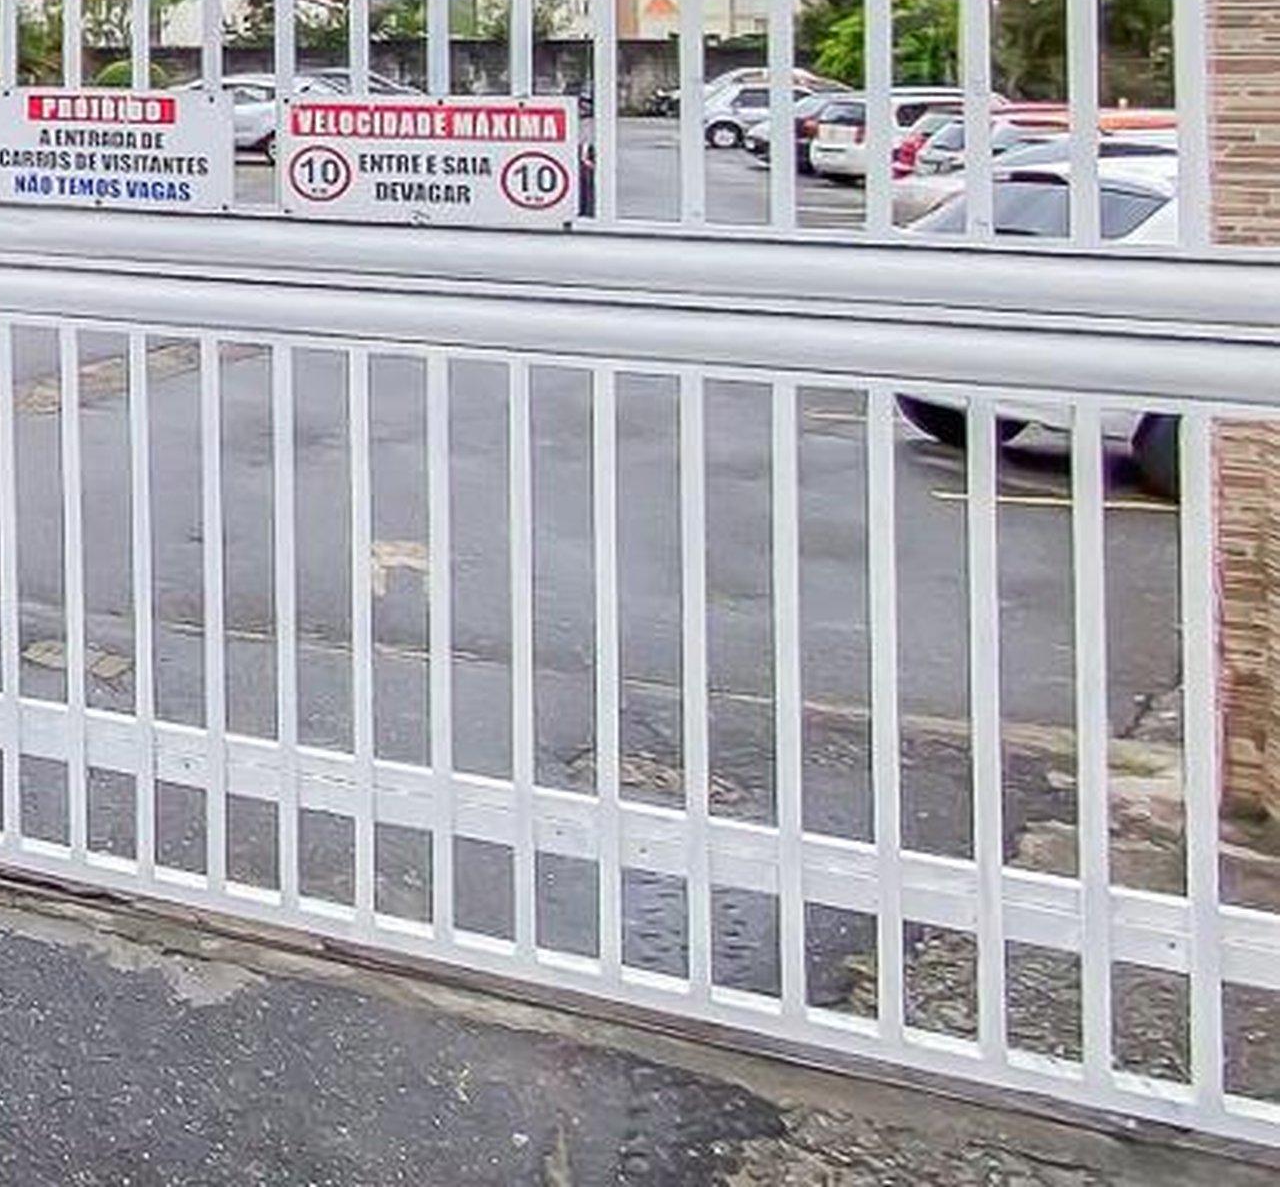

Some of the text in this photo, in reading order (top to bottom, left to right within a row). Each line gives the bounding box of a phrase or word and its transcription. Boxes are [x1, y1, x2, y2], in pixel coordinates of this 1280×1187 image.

[42, 97, 161, 122] PROIBIDO
[297, 109, 446, 137] VELOCIDADE
[39, 129, 165, 149] A ENTRADA DE
[0, 148, 209, 176] CARROS DE VISITANTES
[301, 157, 340, 186] 10
[359, 153, 491, 176] ENTRE E SAIA
[15, 172, 191, 201] NÃO TEMOS VAGAS
[513, 164, 557, 193] 10
[376, 182, 471, 204] DEVAGAR
